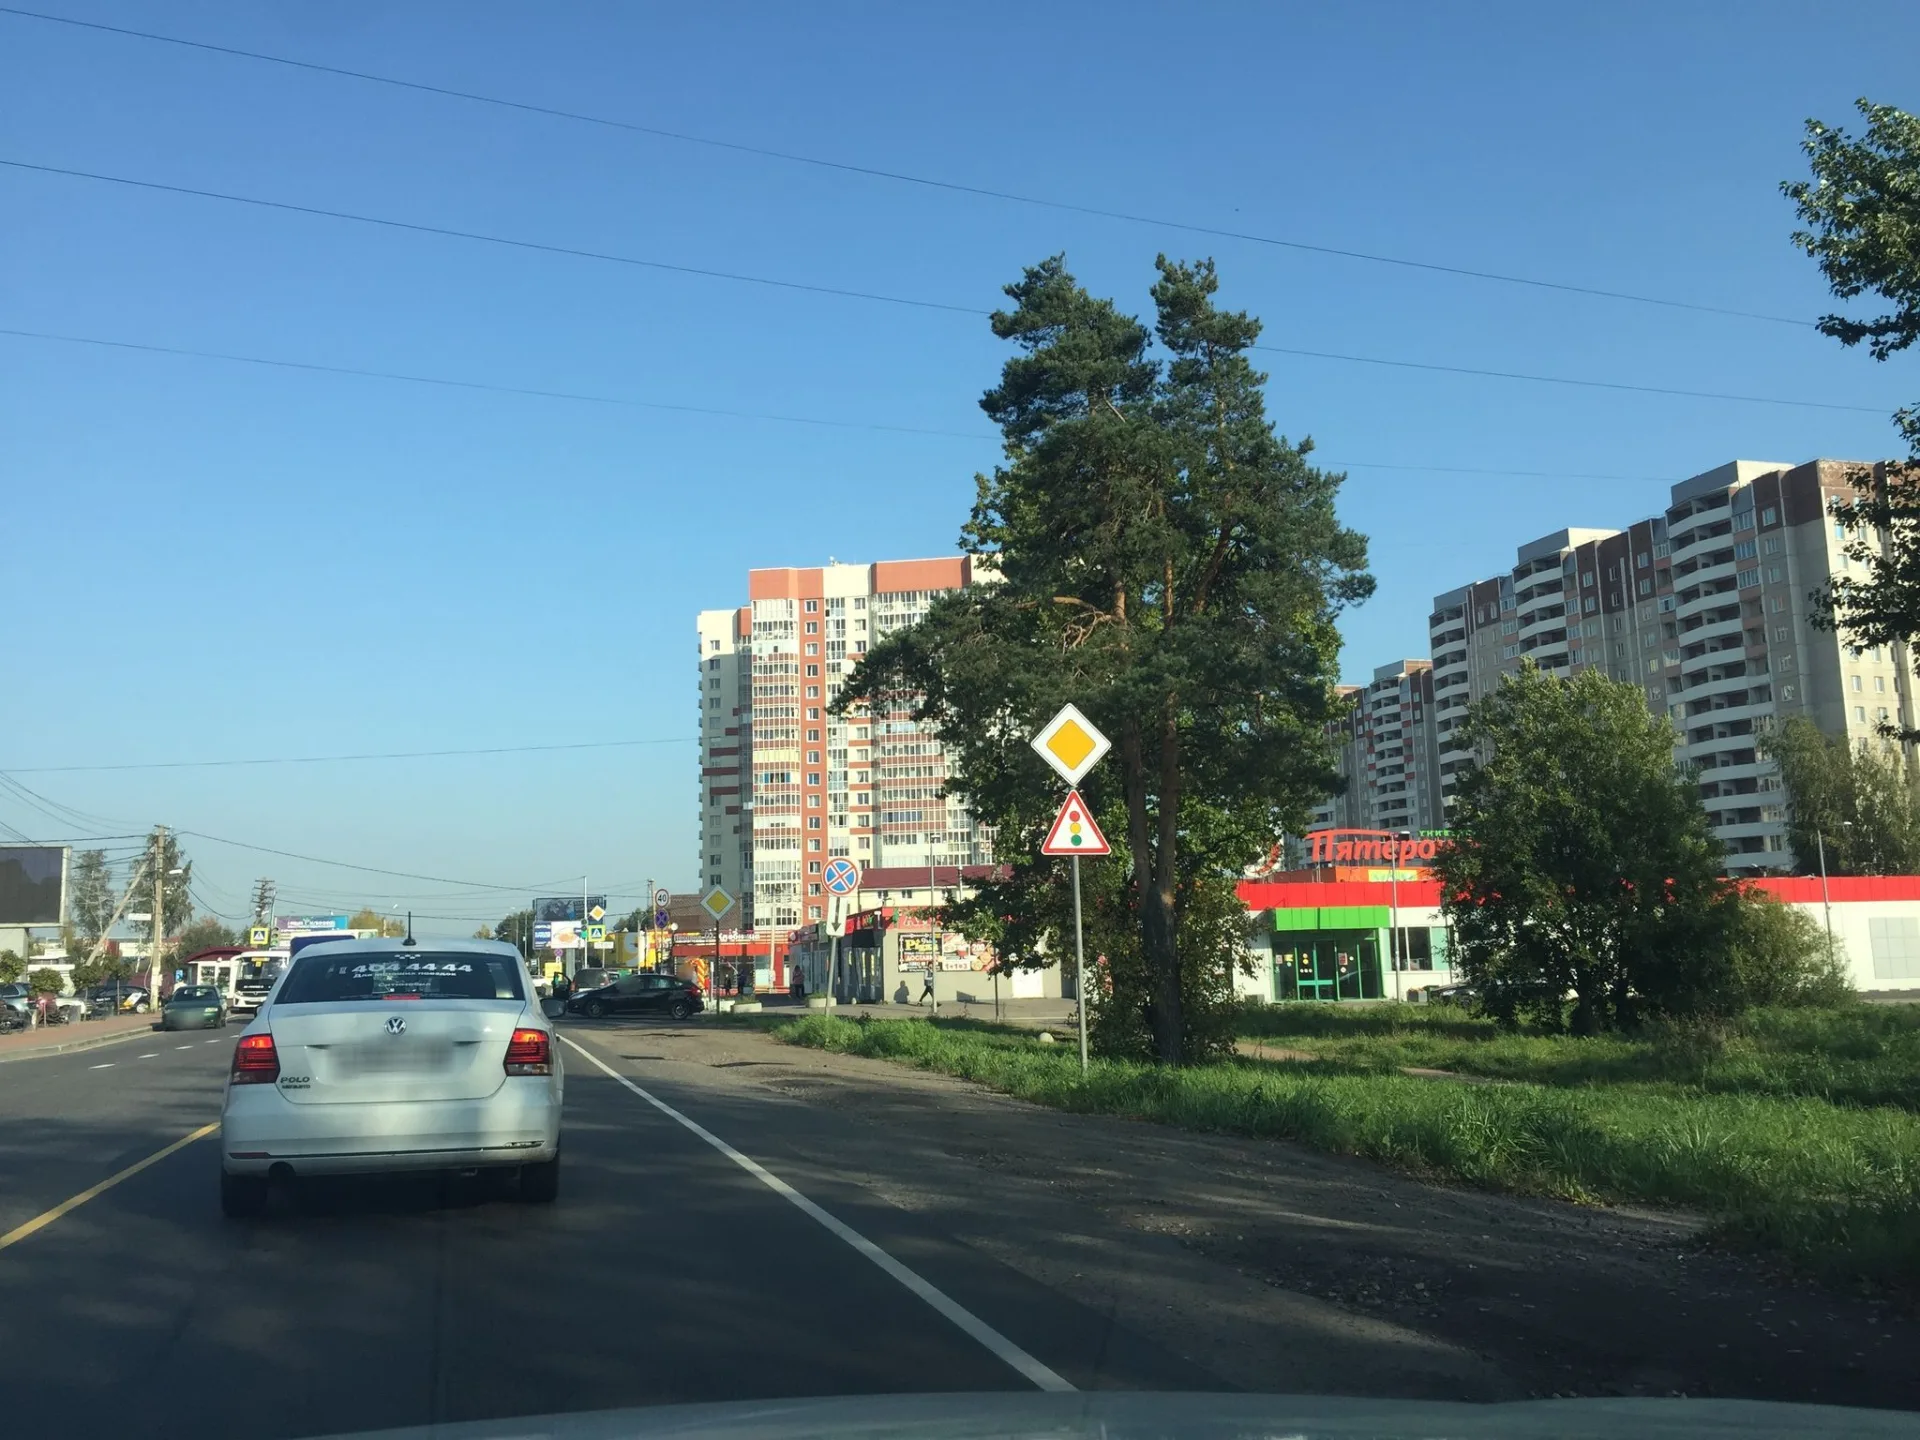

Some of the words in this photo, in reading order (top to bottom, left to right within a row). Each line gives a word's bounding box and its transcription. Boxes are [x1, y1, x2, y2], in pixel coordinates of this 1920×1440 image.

[657, 894, 667, 903] 40
[405, 962, 437, 971] 44
[442, 963, 473, 973] 44
